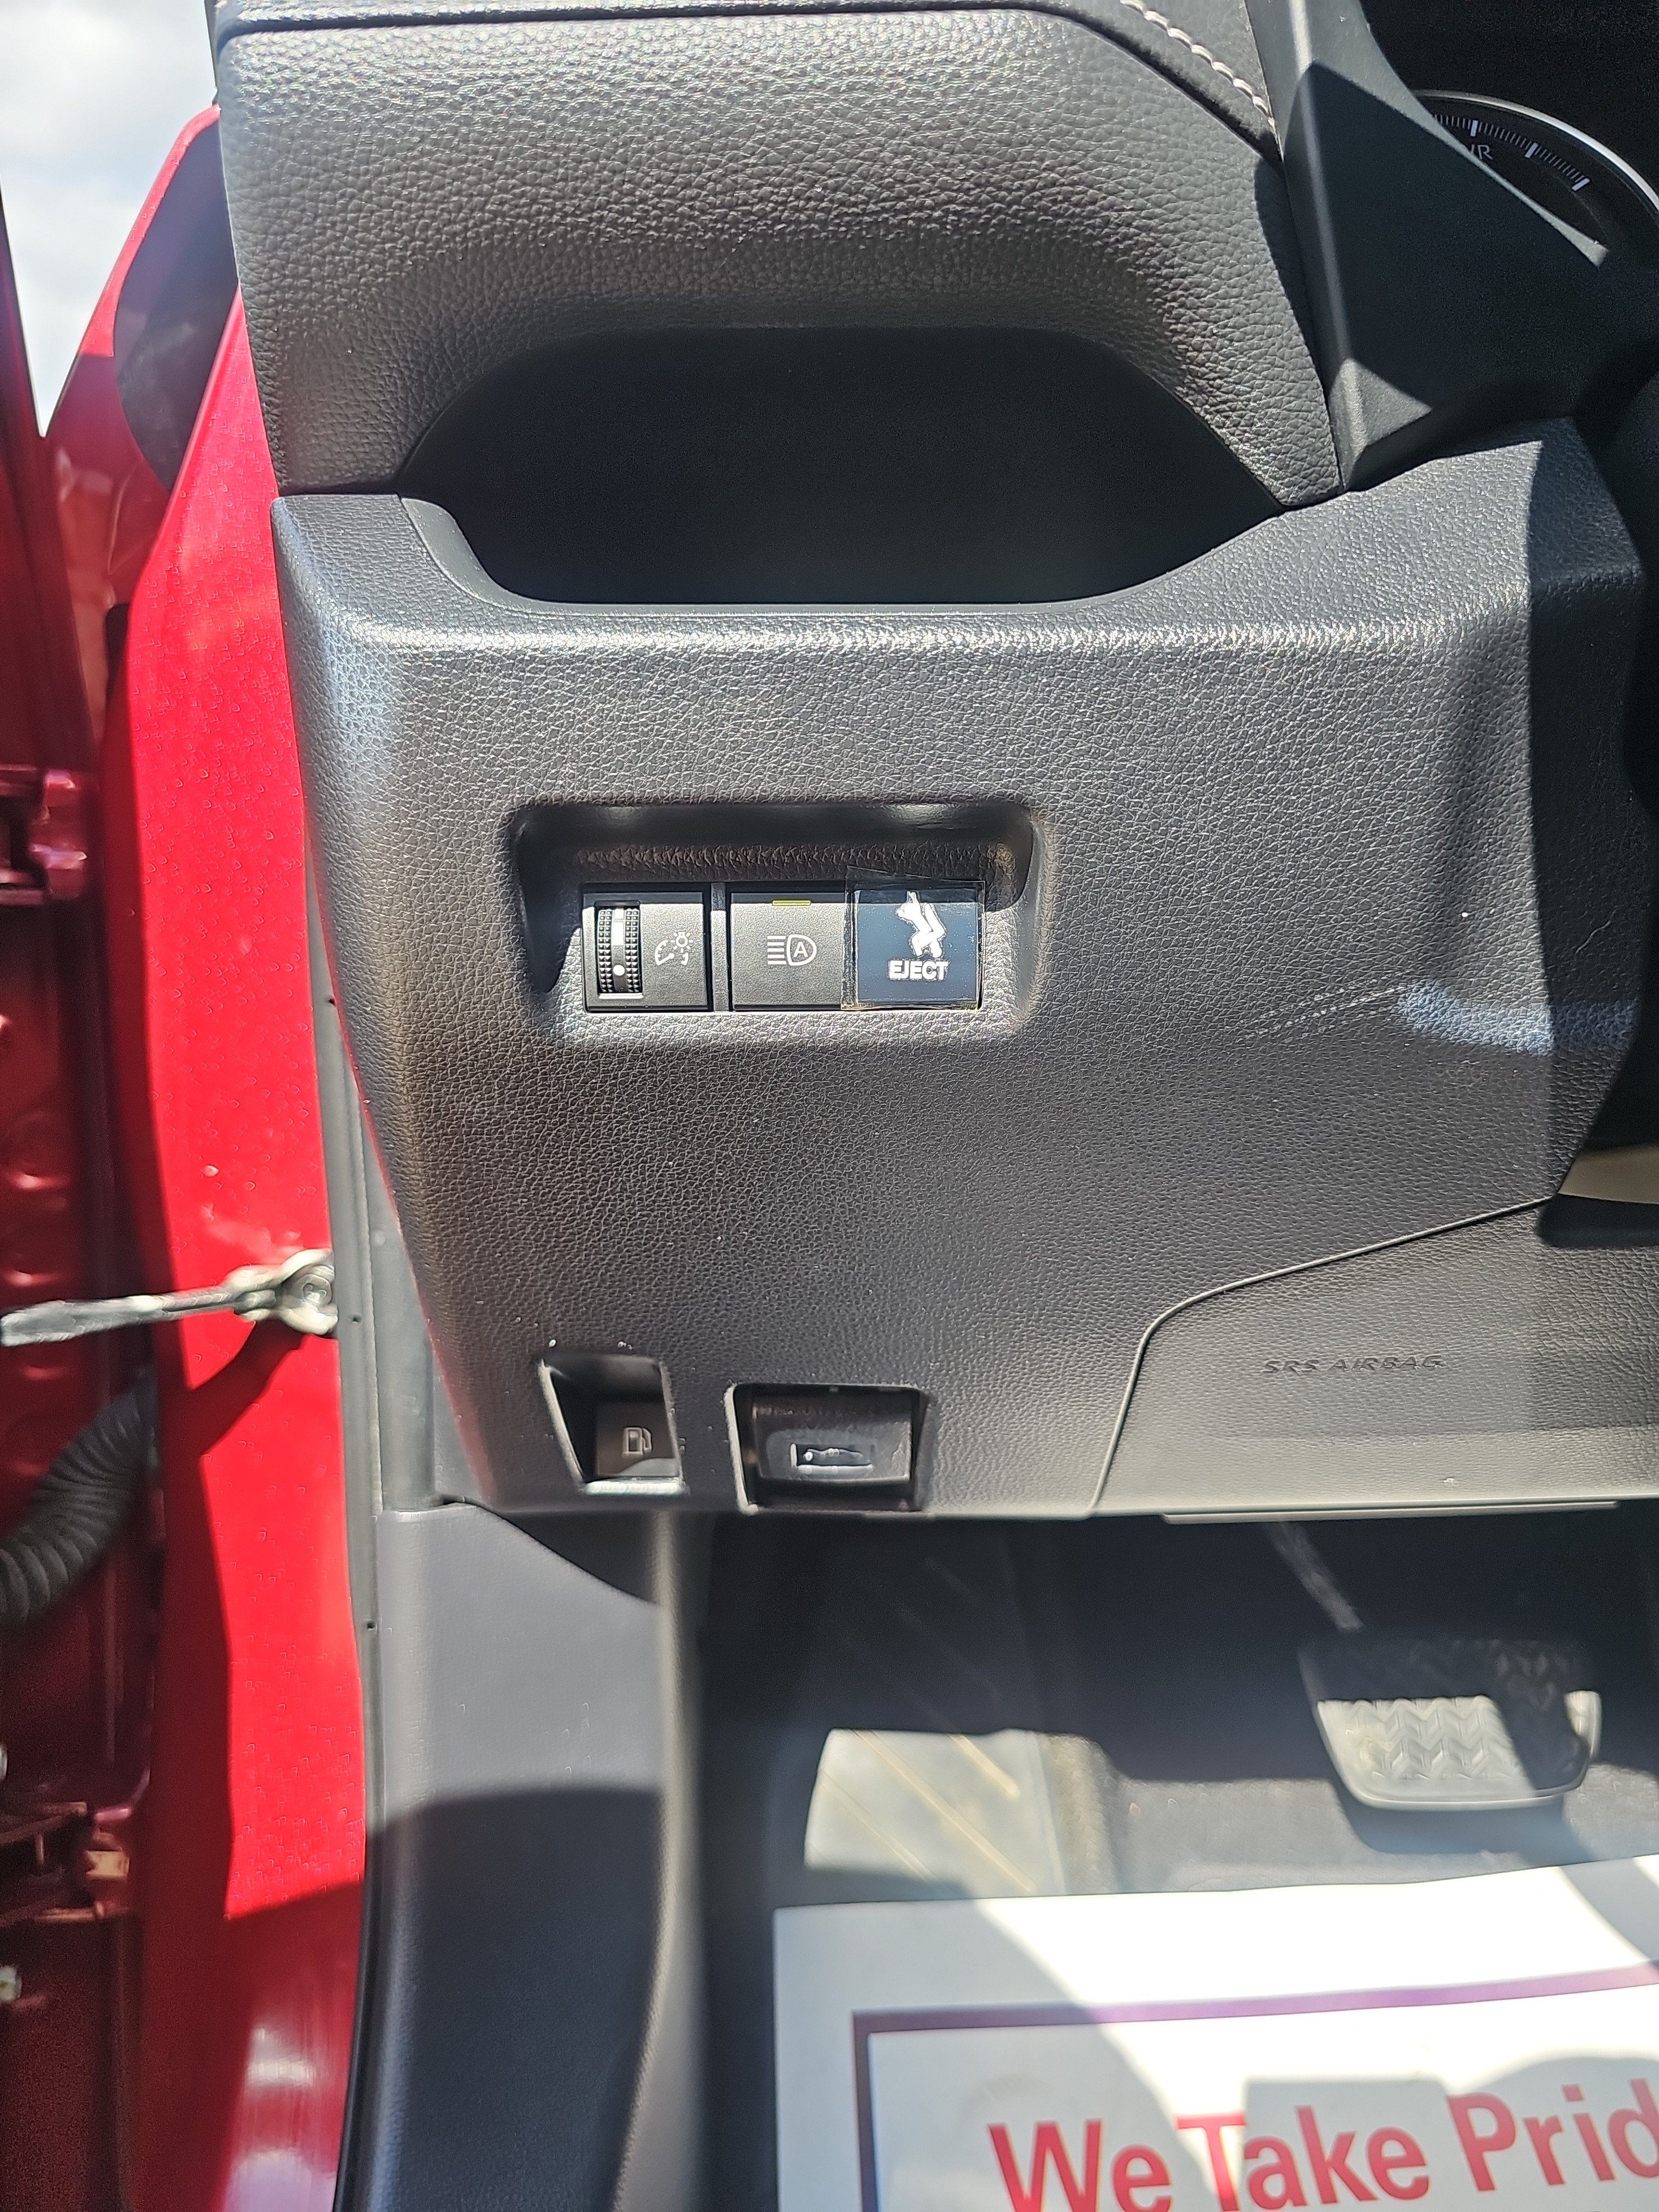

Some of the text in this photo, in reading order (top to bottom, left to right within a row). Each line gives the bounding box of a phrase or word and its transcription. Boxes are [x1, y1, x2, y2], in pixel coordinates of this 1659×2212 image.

[793, 941, 808, 957] A
[889, 960, 949, 980] EJECT
[1263, 1355, 1446, 1375] SRS AIRBAG
[987, 2117, 1173, 2212] We
[1175, 2105, 1430, 2212] Take
